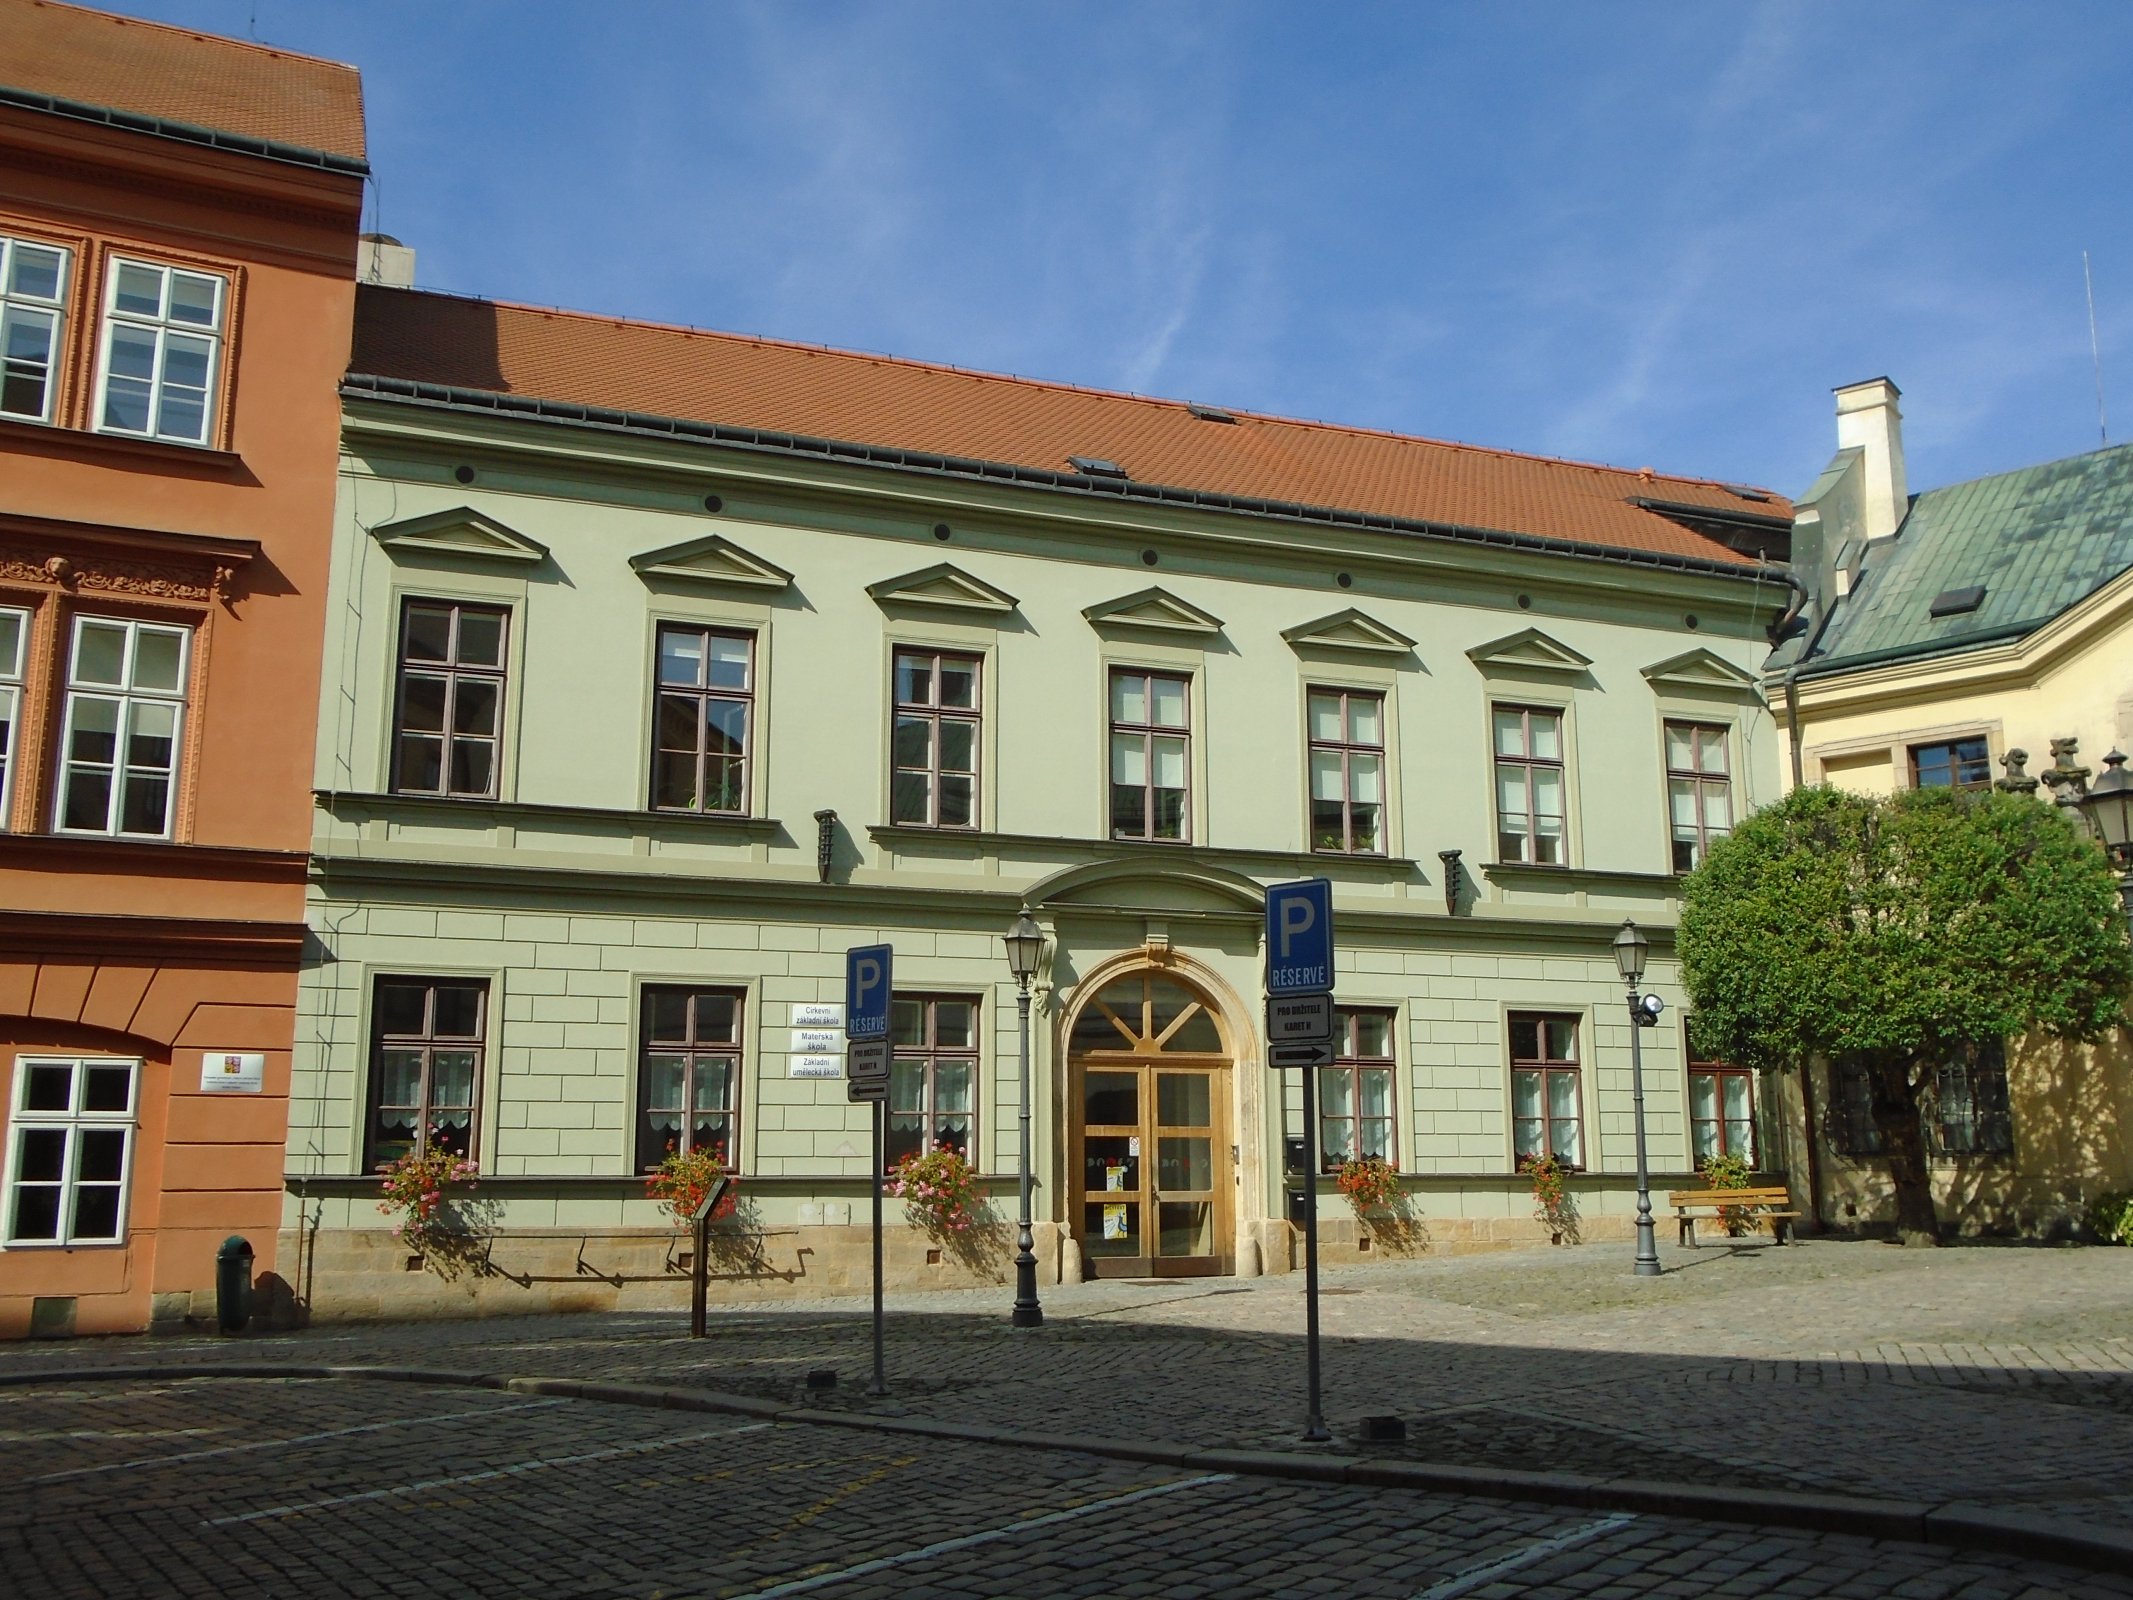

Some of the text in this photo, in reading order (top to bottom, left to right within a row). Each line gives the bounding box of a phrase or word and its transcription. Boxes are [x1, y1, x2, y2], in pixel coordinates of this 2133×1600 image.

[1273, 963, 1325, 986] RÉSERVÉ
[805, 1006, 831, 1014] Církevní
[1277, 1003, 1321, 1016] PRO DRŽITELE
[796, 1015, 839, 1024] základní škola
[849, 1013, 885, 1033] RÉSERVÉ
[1284, 1021, 1305, 1031] KARET
[801, 1032, 833, 1040] Mateřská
[807, 1043, 827, 1051] škola
[803, 1057, 830, 1066] Základní
[792, 1067, 840, 1076] umělecká škola
